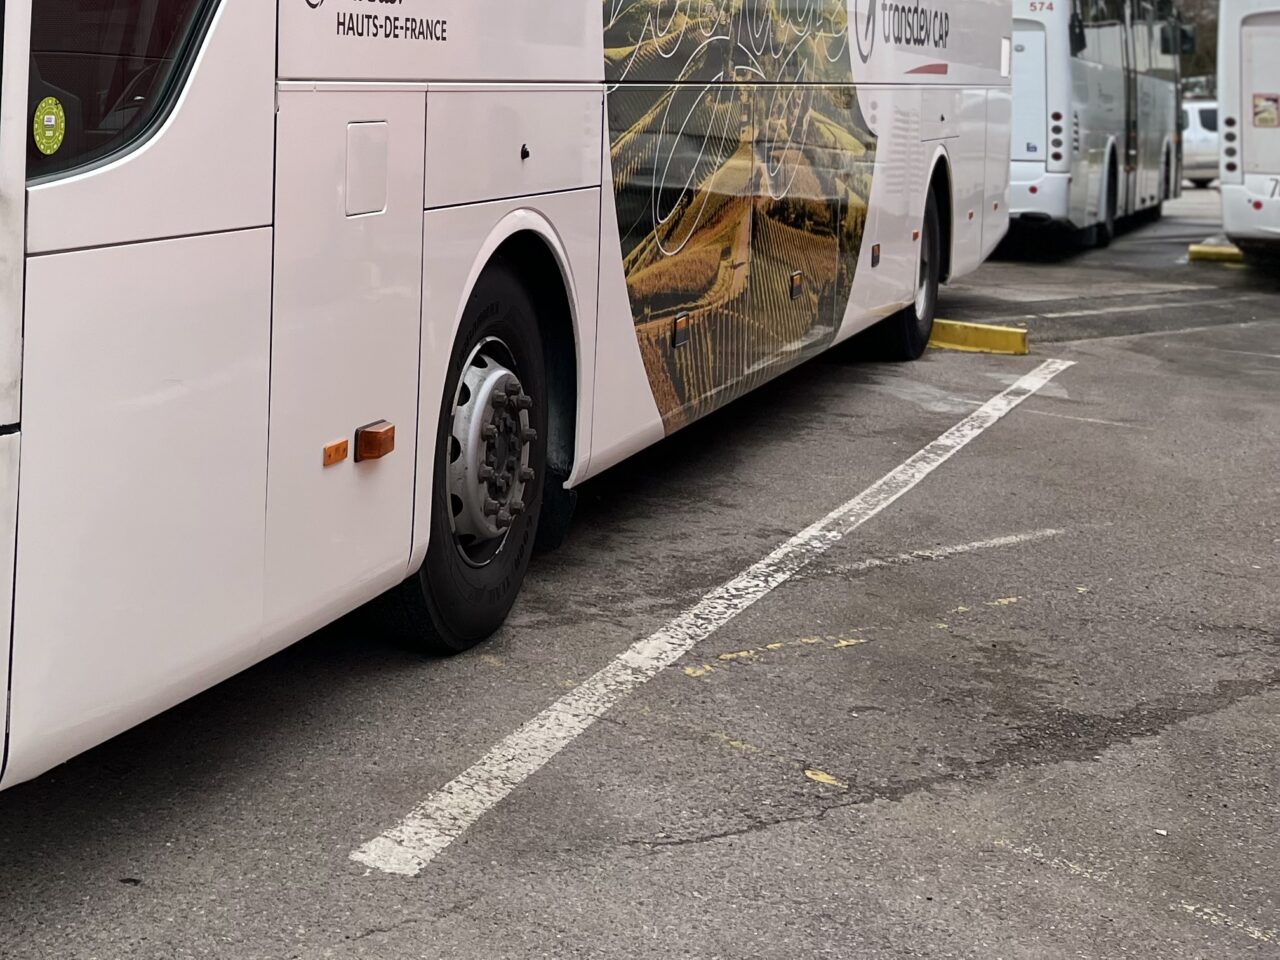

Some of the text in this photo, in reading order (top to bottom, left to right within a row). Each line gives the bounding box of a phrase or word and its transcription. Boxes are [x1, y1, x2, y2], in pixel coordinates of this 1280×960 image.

[1029, 1, 1055, 12] 574
[336, 11, 447, 42] HAUTS-DE-FRANCE
[932, 9, 950, 49] CAP
